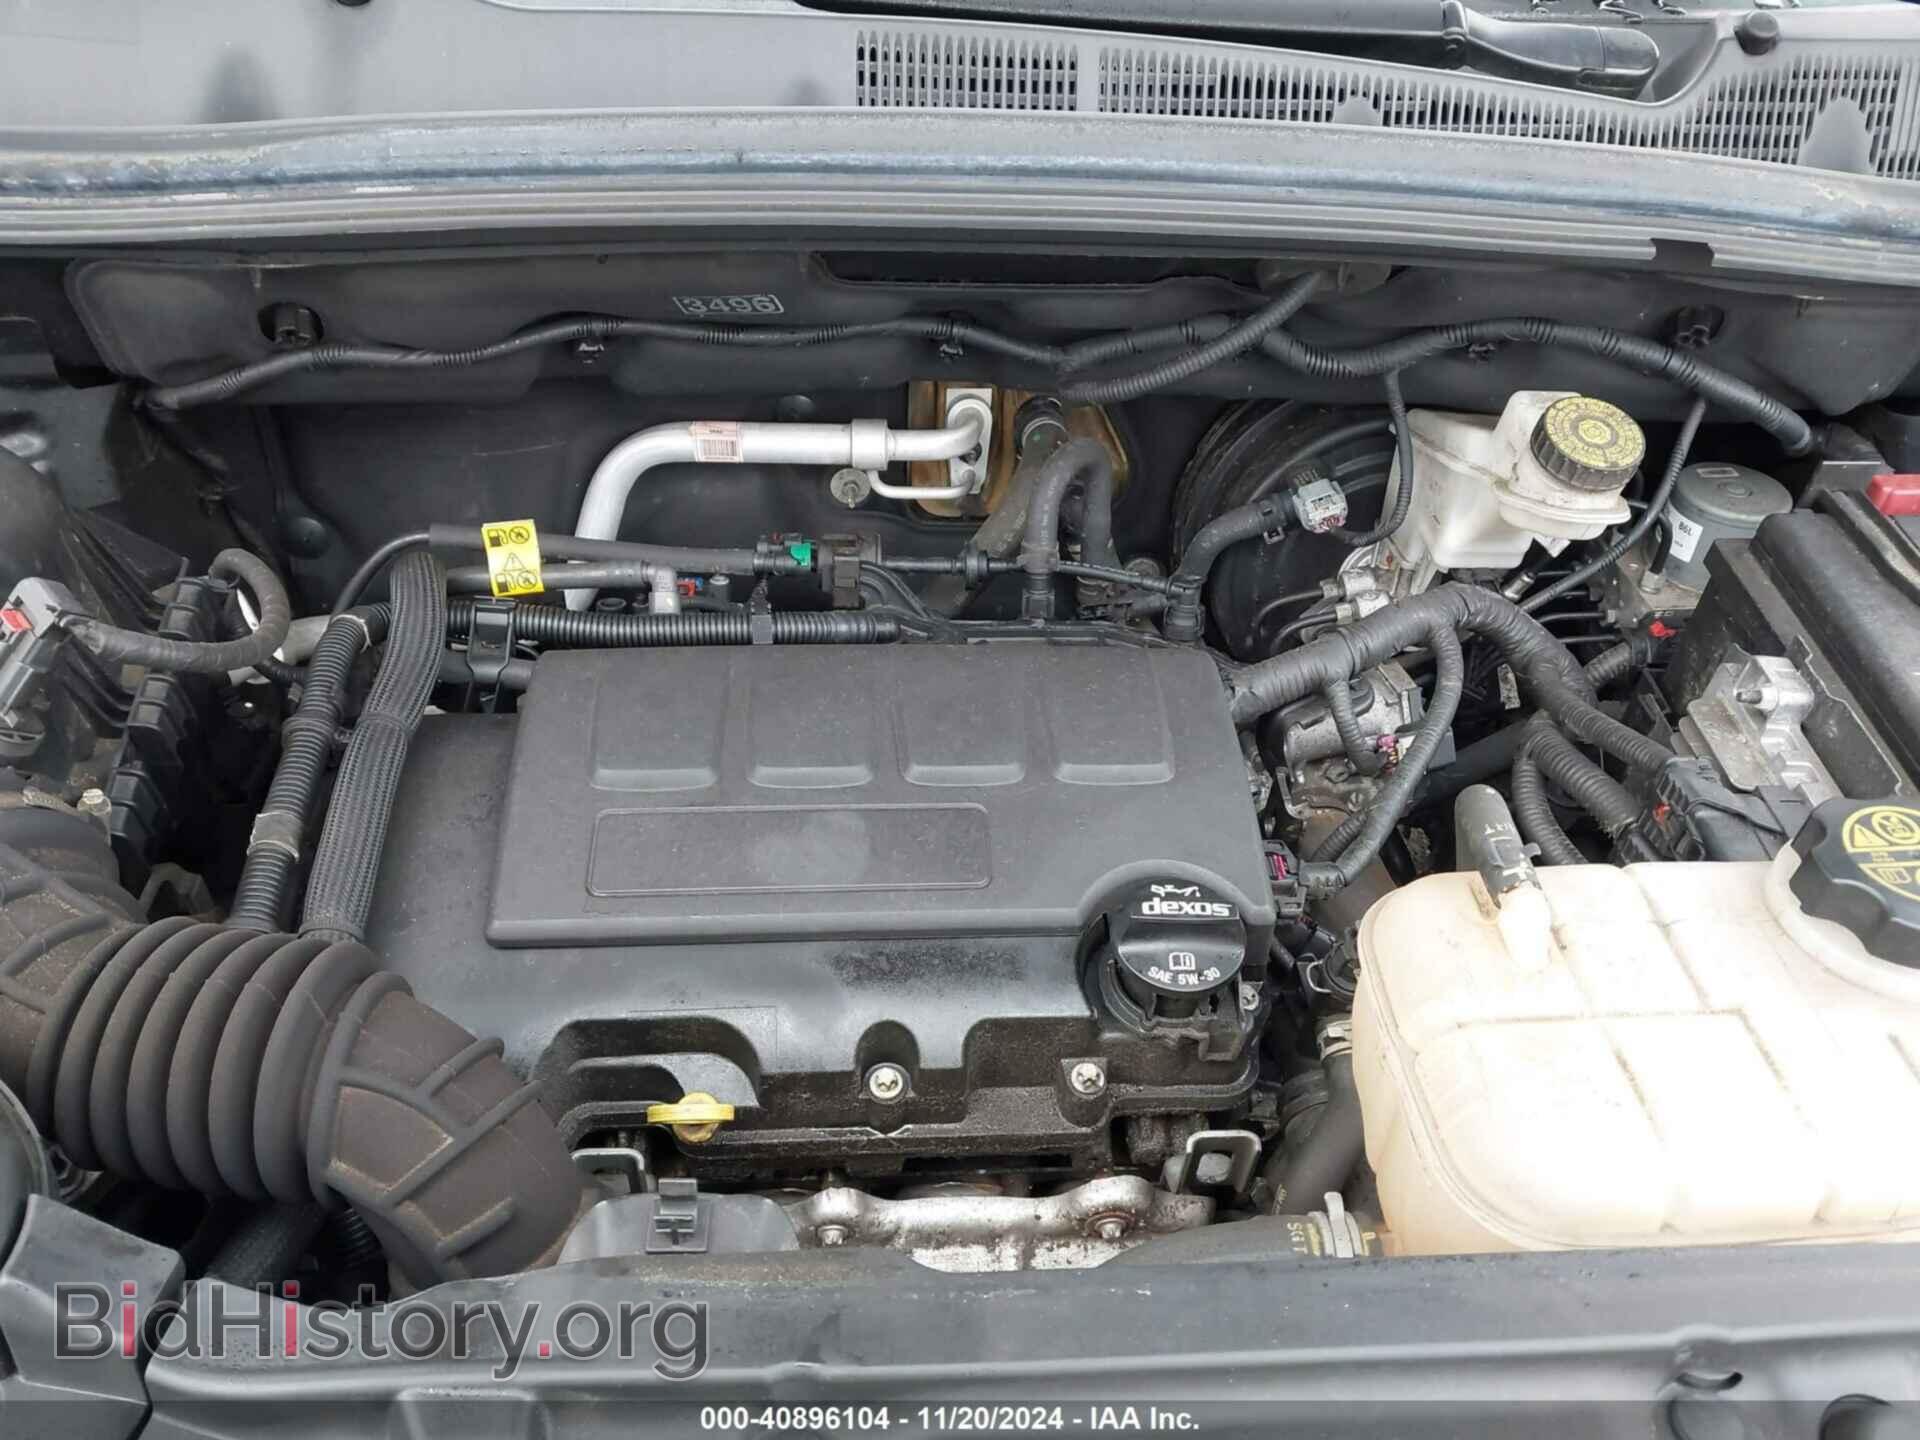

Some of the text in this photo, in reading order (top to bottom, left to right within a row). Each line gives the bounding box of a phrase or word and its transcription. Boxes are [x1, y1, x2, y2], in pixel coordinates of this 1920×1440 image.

[683, 297, 776, 313] 3496
[1141, 897, 1232, 917] dexos
[1147, 966, 1221, 985] SAE 5W-30
